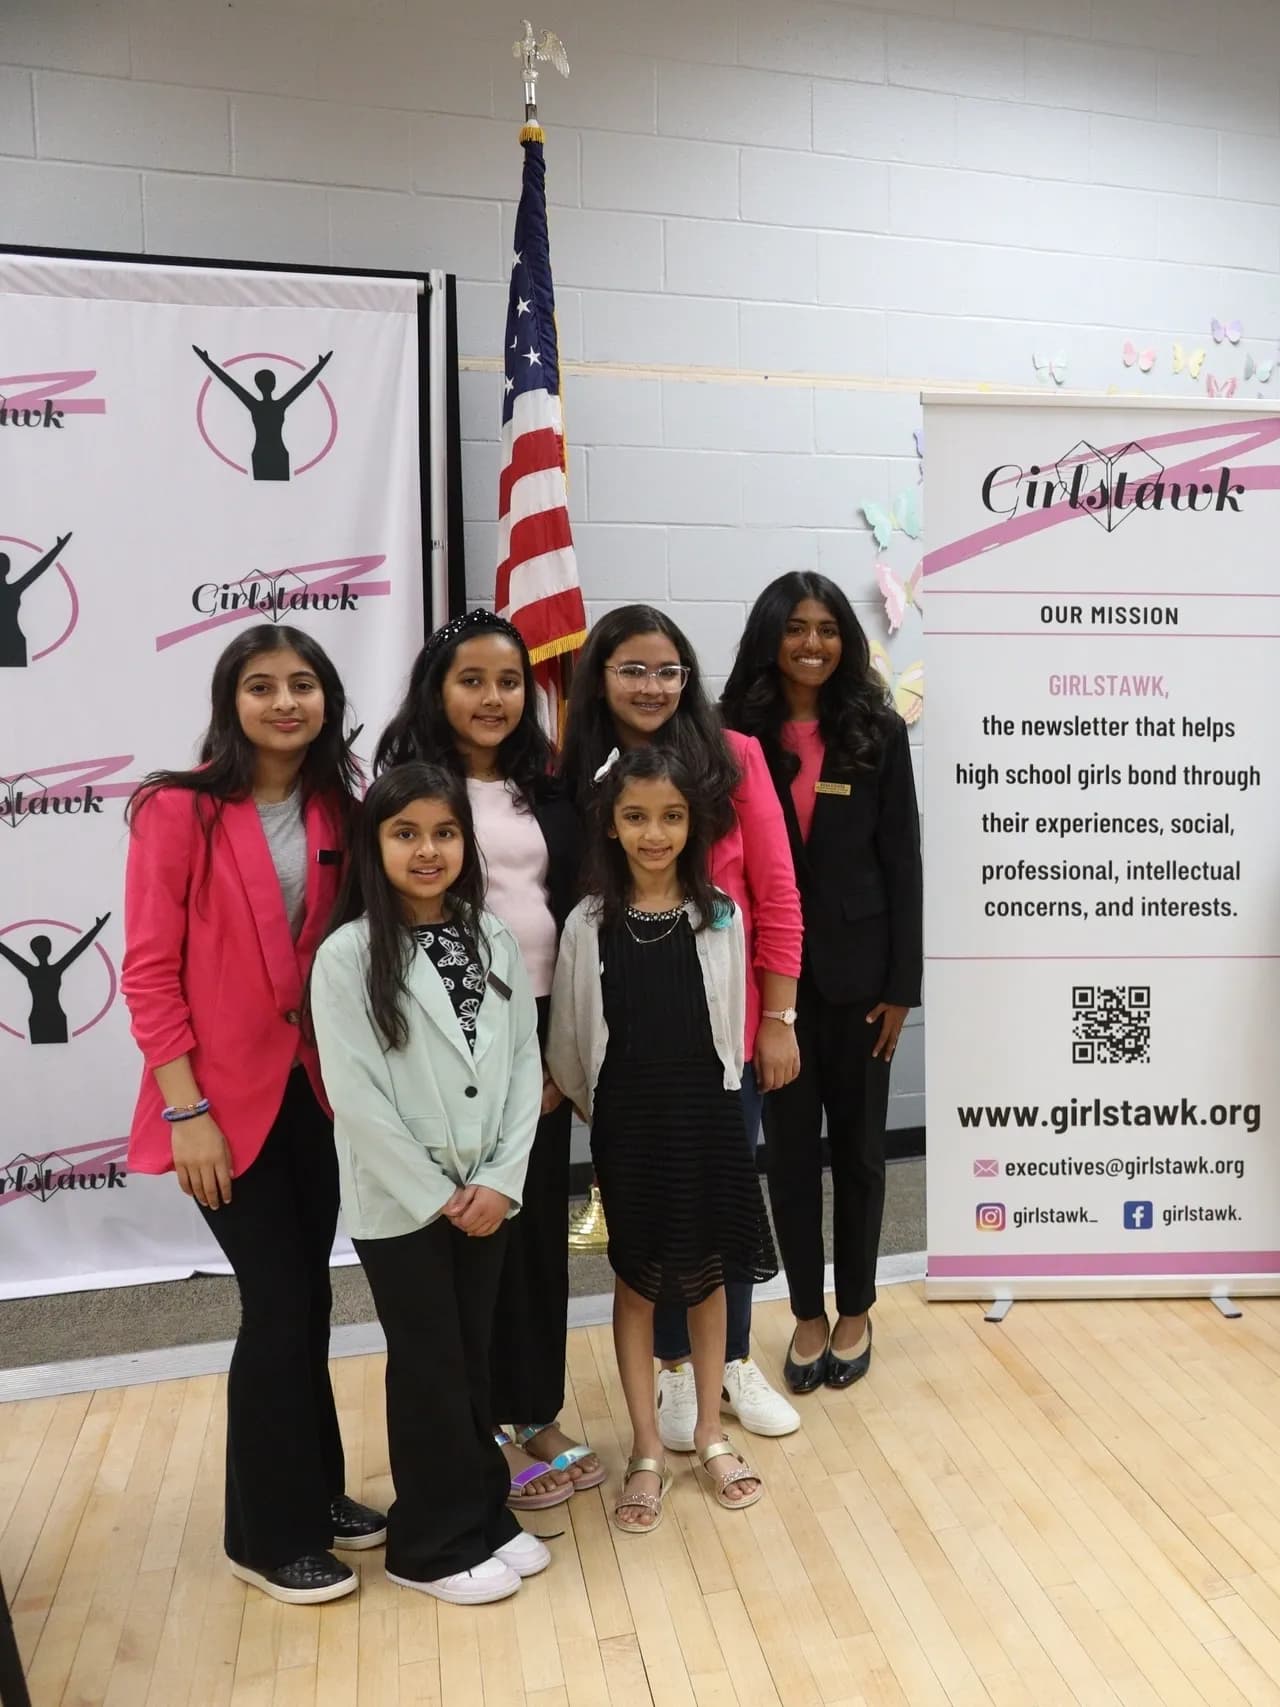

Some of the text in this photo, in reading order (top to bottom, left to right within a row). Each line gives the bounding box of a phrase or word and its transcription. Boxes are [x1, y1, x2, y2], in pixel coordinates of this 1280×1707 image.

[981, 463, 1245, 521] Girlstawk
[191, 582, 358, 617] Girlstawk
[1040, 605, 1179, 625] OUR MISSION
[1048, 674, 1169, 701] GIRLSTAWK,
[981, 714, 1236, 743] the newsletter that helps
[955, 762, 1261, 792] high school girls bond through
[981, 811, 1235, 839] their experiences, social,
[981, 859, 1241, 885] professional, intellectual
[984, 895, 1238, 921] concerns, and interests.
[956, 1097, 1261, 1135] www.girlstawk.org
[1005, 1155, 1245, 1181] executives@girlstawk.org
[1013, 1206, 1099, 1229] girlstawk_
[1162, 1204, 1243, 1227] girlstawk.
